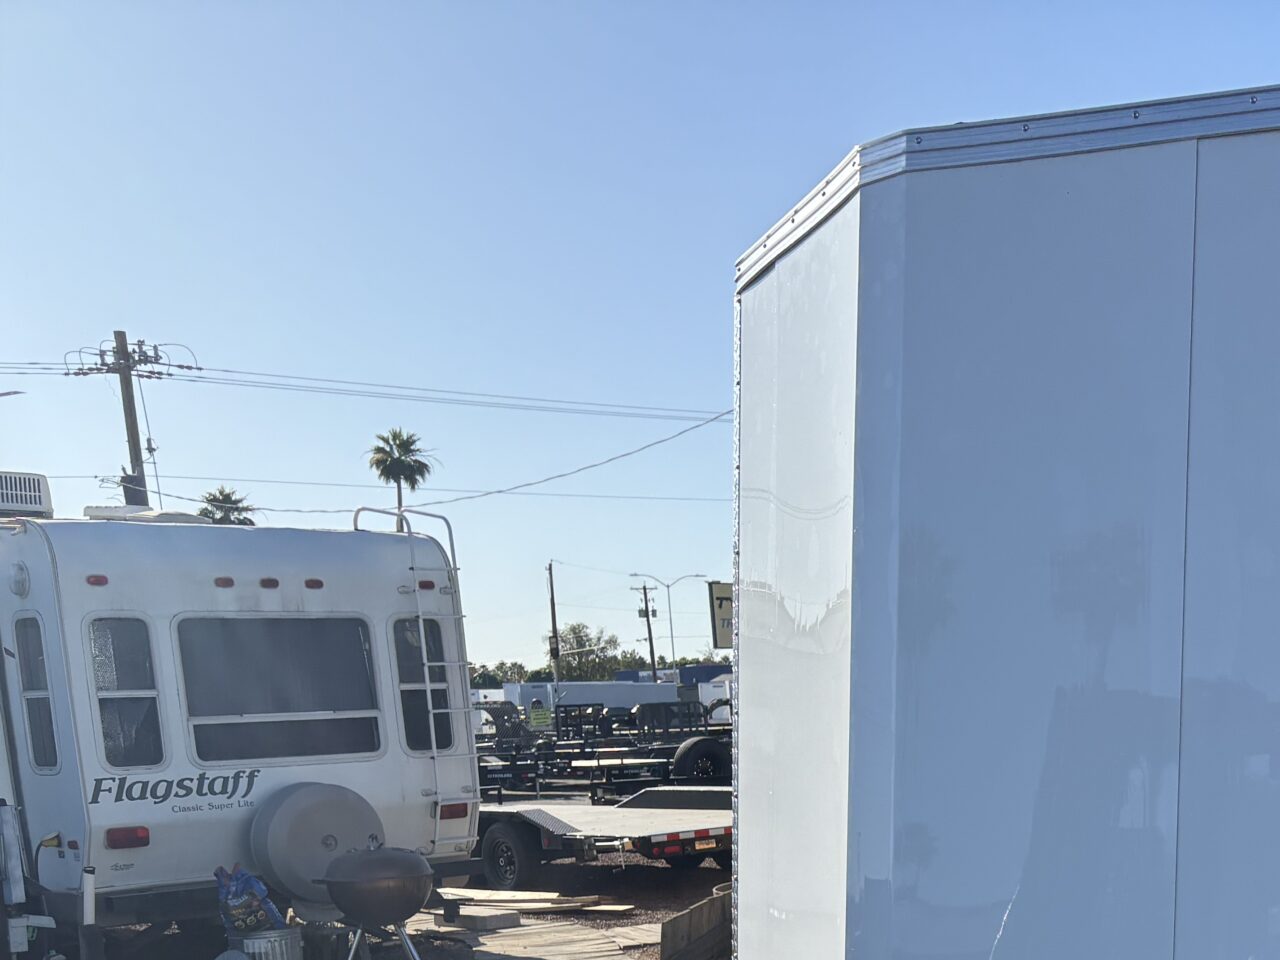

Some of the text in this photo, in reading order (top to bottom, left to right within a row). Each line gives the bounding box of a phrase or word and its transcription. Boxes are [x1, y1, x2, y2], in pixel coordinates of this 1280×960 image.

[88, 769, 261, 805] Flagstaff
[171, 799, 255, 814] Classic Super Lite
